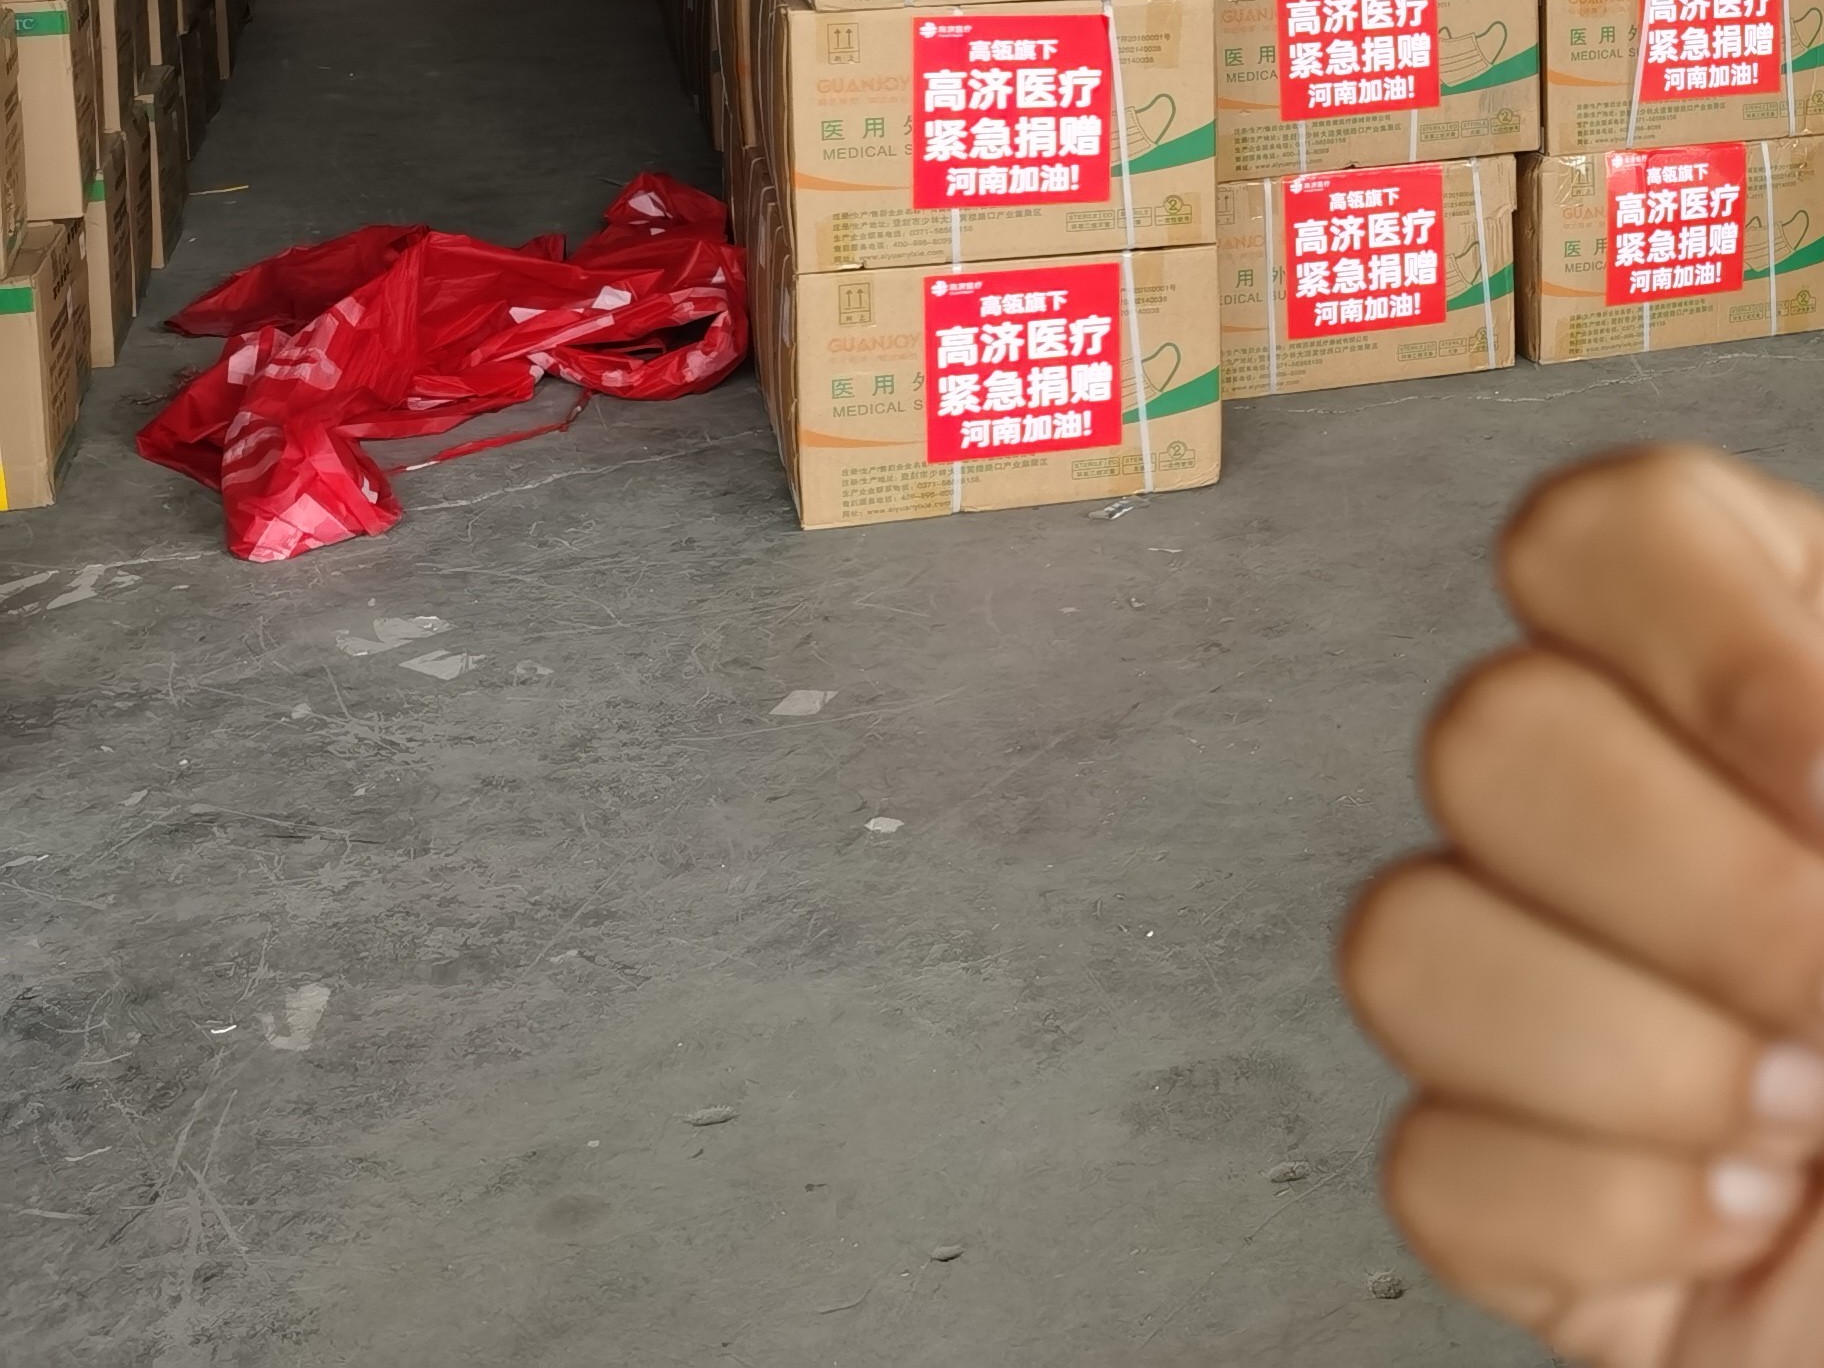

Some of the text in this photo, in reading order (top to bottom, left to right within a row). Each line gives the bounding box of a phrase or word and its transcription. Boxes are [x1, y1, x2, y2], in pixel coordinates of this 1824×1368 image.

[968, 39, 1058, 62] 高瓴旗下
[1289, 33, 1431, 79] 紧急捐赠
[1571, 47, 1625, 61] MEDICAL
[1648, 23, 1774, 64] 紧急捐赠
[923, 67, 1101, 111] 高济医疗
[1308, 75, 1415, 109] 河南加油!
[1664, 62, 1758, 91] 河南加油!
[823, 145, 897, 160] MEDICAL
[924, 117, 1101, 162] 紧急捐赠
[946, 165, 1078, 196] 河南加油!
[1647, 163, 1709, 185] 高瓴旗下
[1329, 188, 1400, 211] 高瓴旗下
[1616, 184, 1740, 228] 高济医疗
[1294, 208, 1436, 256] 高济医疗
[1615, 223, 1738, 267] 紧急捐赠
[1296, 250, 1438, 298] 紧急捐赠
[1630, 262, 1721, 294] 河南加油!
[980, 290, 1067, 317] 高瓴旗下
[1314, 293, 1421, 327] 河南加油!
[936, 315, 1111, 368] 高济医疗
[937, 362, 1113, 416] 紧急捐赠
[833, 401, 907, 417] MEDICAL
[960, 411, 1092, 448] 河南加油!
